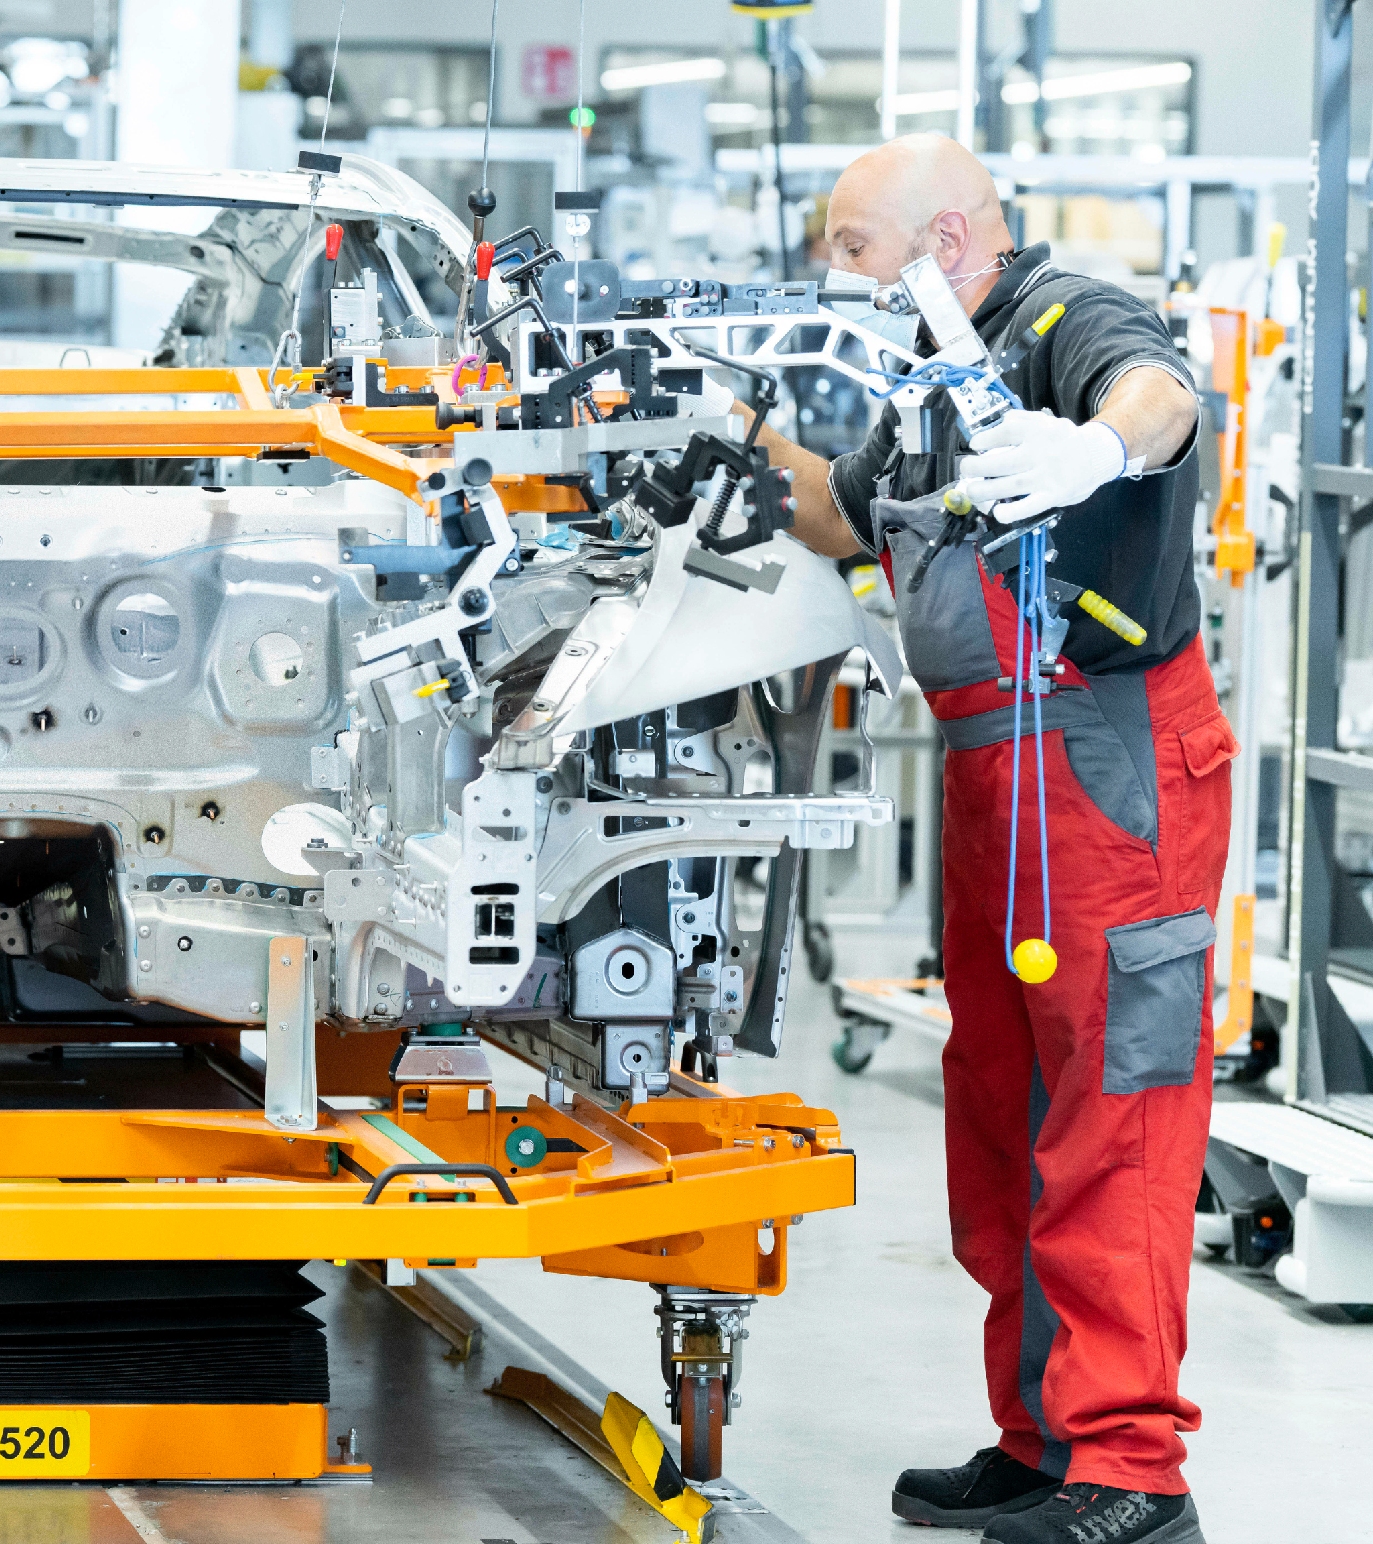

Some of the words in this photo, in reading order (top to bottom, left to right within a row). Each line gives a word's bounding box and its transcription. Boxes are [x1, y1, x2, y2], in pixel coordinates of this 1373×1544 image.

[1307, 140, 1320, 220] AUDI
[1303, 239, 1317, 413] EIGENTUM
[1066, 1491, 1158, 1544] uvex
